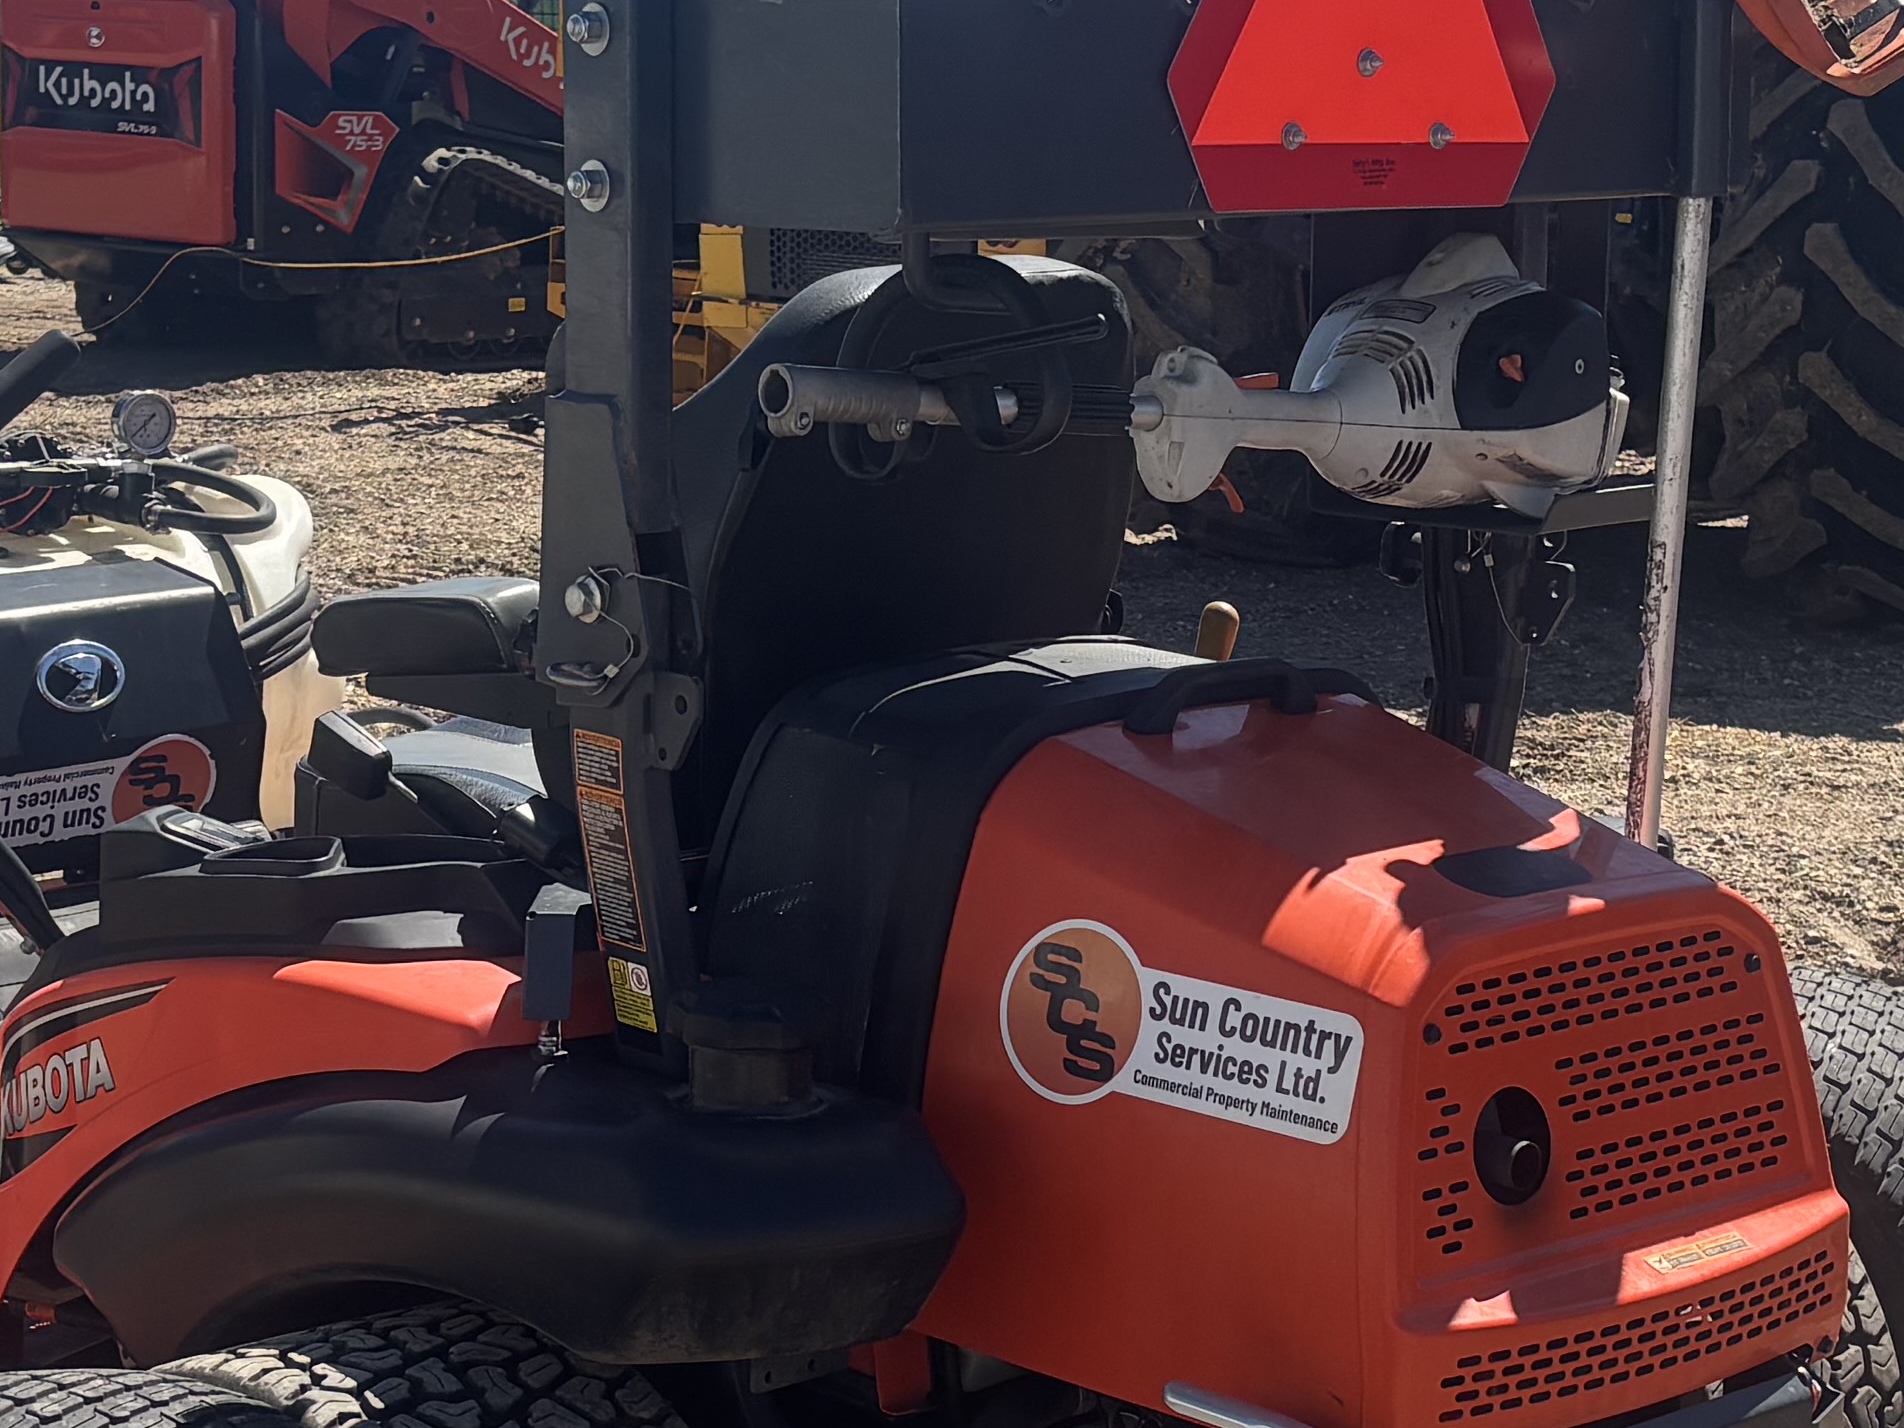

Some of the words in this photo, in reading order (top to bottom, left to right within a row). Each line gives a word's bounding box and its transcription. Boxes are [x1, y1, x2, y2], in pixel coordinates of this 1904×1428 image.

[500, 17, 561, 83] Kub
[39, 64, 155, 113] Kubota
[335, 115, 381, 135] SVL
[345, 136, 384, 151] 75-3
[17, 783, 100, 810] Services
[24, 772, 61, 788] Property
[63, 805, 106, 830] Sun
[1028, 941, 1116, 1084] SCS
[1149, 980, 1210, 1033] Sun
[1218, 997, 1353, 1075] Country
[3, 1036, 116, 1136] KUBOTA
[1153, 1031, 1268, 1090] Services
[1275, 1059, 1326, 1104] Ltd.
[1133, 1068, 1203, 1100] Commercial
[1205, 1086, 1258, 1118] Property
[1260, 1100, 1339, 1135] Maintenance
